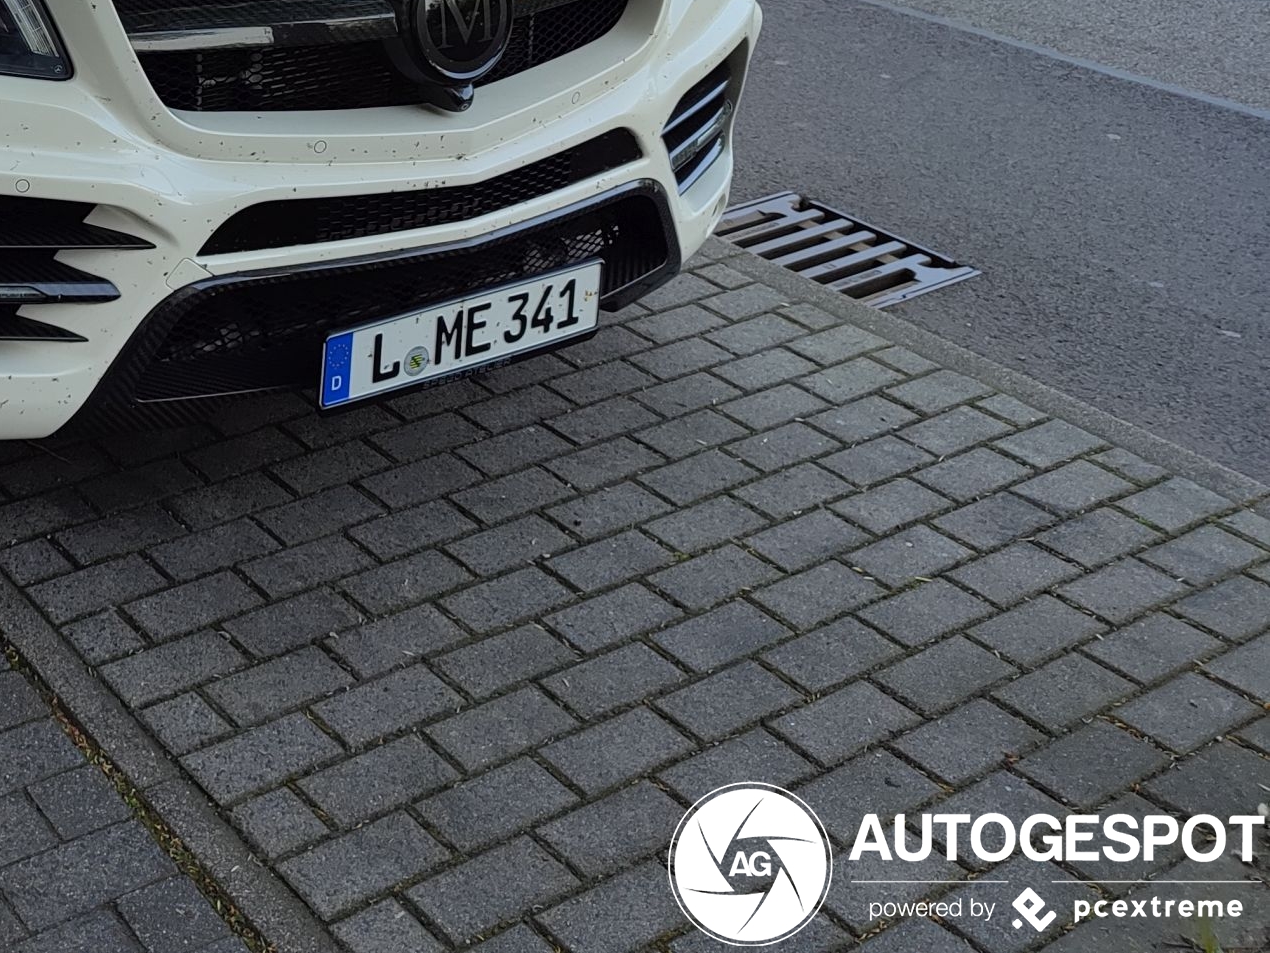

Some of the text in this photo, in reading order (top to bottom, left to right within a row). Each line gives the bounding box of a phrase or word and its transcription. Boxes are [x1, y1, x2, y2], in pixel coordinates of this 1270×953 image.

[372, 278, 579, 384] L ME 341
[331, 375, 343, 392] D
[423, 373, 463, 390] SPEED
